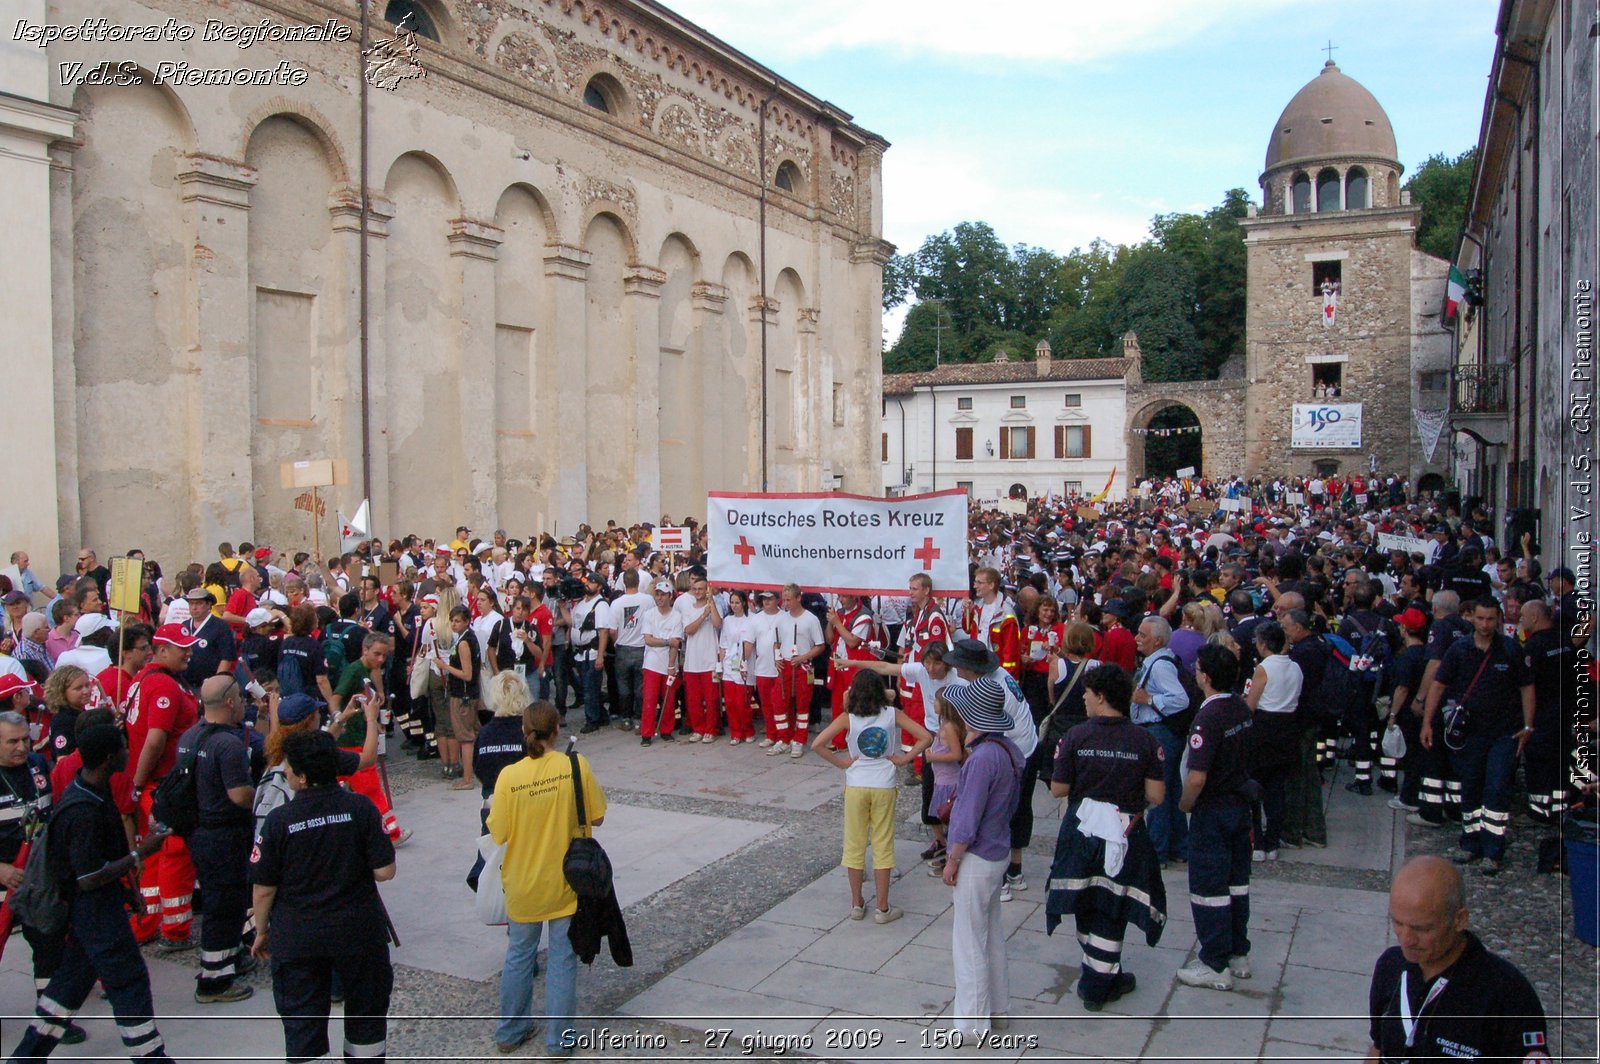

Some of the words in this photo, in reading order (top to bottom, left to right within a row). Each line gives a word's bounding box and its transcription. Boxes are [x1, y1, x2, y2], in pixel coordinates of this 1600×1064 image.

[1308, 407, 1341, 433] 150
[727, 509, 816, 528] Deutsches
[823, 509, 881, 528] Rotes
[888, 509, 945, 528] Kreuz
[762, 544, 906, 560] Münchenbernsdorf
[502, 744, 523, 752] ITALIANA
[1077, 749, 1095, 757] CROCE
[1096, 750, 1115, 758] ROSSA
[1115, 751, 1139, 760] ITALIANA
[511, 774, 572, 793] Baden-Württember
[529, 785, 558, 797] Germany
[288, 821, 307, 834] CROCE
[307, 816, 327, 828] ROSSA
[326, 813, 352, 824] ITALIANA
[1436, 1037, 1460, 1050] CROCE
[1460, 1044, 1480, 1056] ROSS
